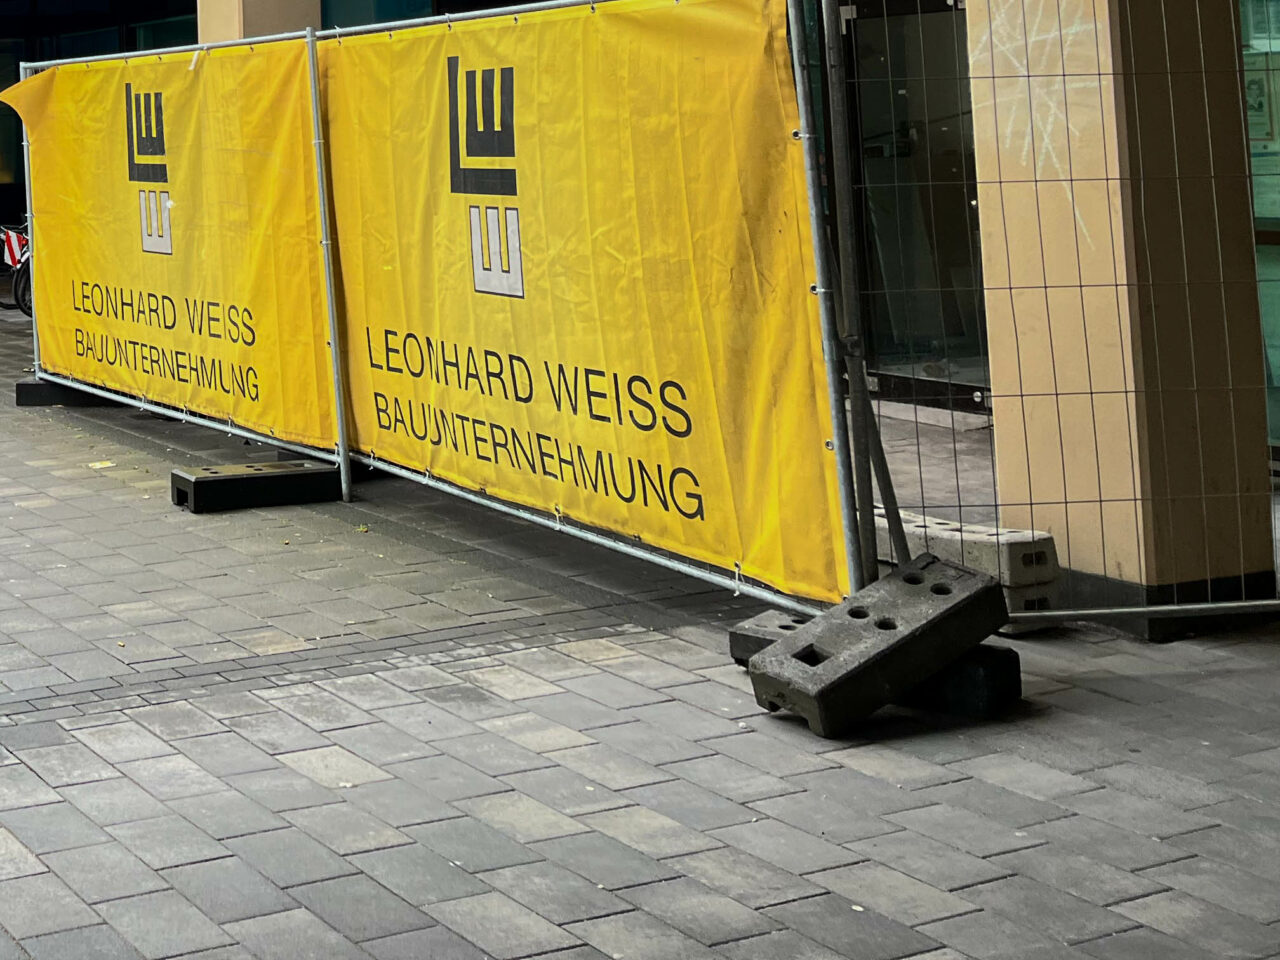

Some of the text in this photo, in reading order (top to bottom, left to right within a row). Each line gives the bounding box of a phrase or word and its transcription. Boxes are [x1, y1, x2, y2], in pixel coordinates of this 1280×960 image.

[71, 279, 256, 347] LEONHARD WEISS
[74, 328, 260, 402] BAUUNTERNEHMUNG
[365, 326, 693, 438] LEONHARD WEISS
[373, 391, 706, 521] BAUUNTERNEHMUNG
